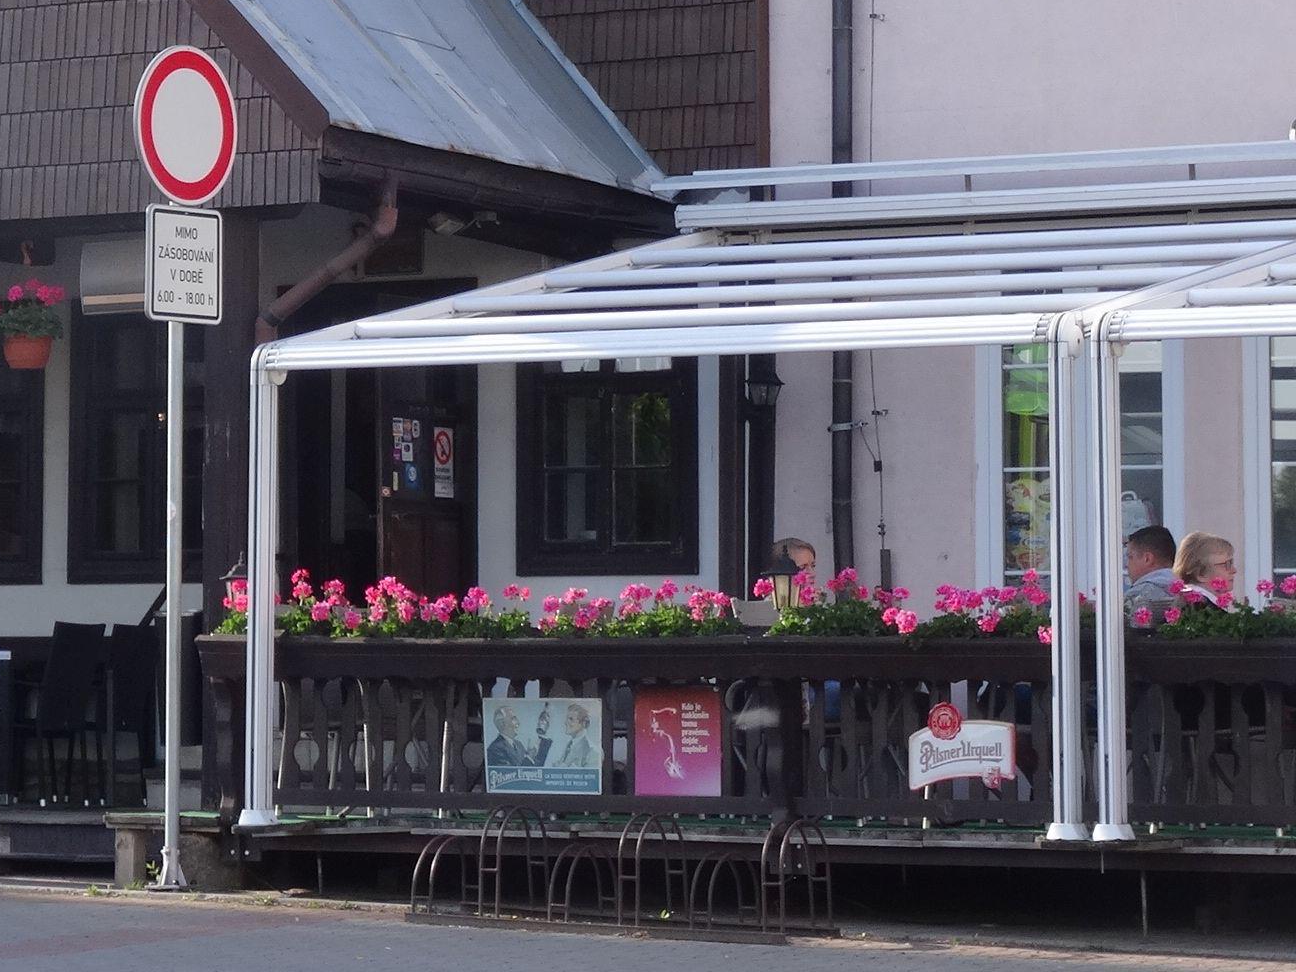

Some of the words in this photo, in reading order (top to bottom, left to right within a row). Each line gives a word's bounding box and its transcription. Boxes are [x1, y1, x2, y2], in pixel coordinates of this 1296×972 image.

[175, 226, 198, 240] MIMO
[158, 244, 215, 263] ZÁSOBOVÁNÍ
[170, 269, 177, 281] V
[179, 268, 204, 283] DOBĚ
[157, 290, 174, 303] 6.00
[185, 292, 206, 306] 18.00
[208, 295, 214, 306] h
[919, 740, 962, 774] Pilsner
[961, 740, 1002, 764] Urquell
